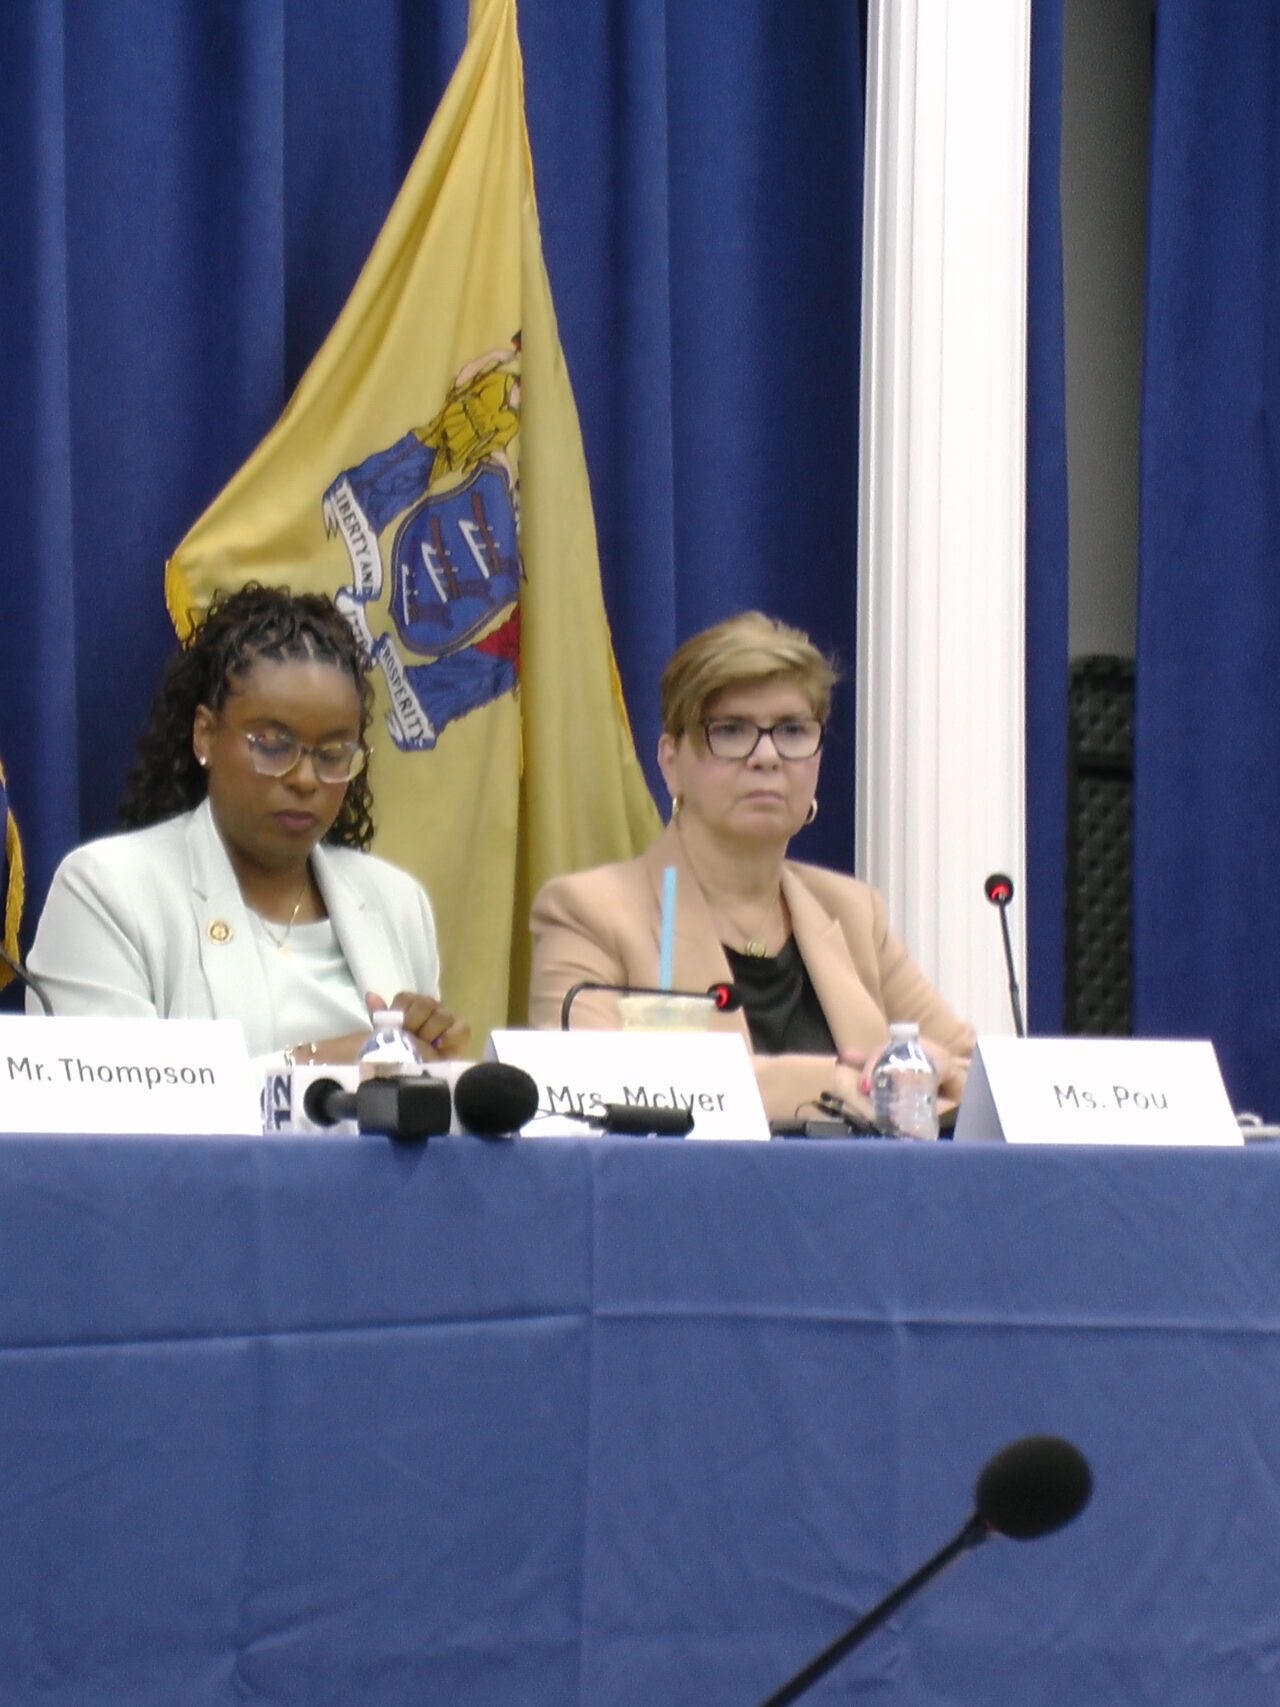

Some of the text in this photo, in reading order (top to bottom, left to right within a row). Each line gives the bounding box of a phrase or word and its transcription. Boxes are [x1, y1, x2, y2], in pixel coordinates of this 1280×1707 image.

[382, 646, 425, 741] ROSPERITY
[6, 1056, 216, 1091] Mr. Thompson
[1053, 1085, 1169, 1110] Ms. Pou
